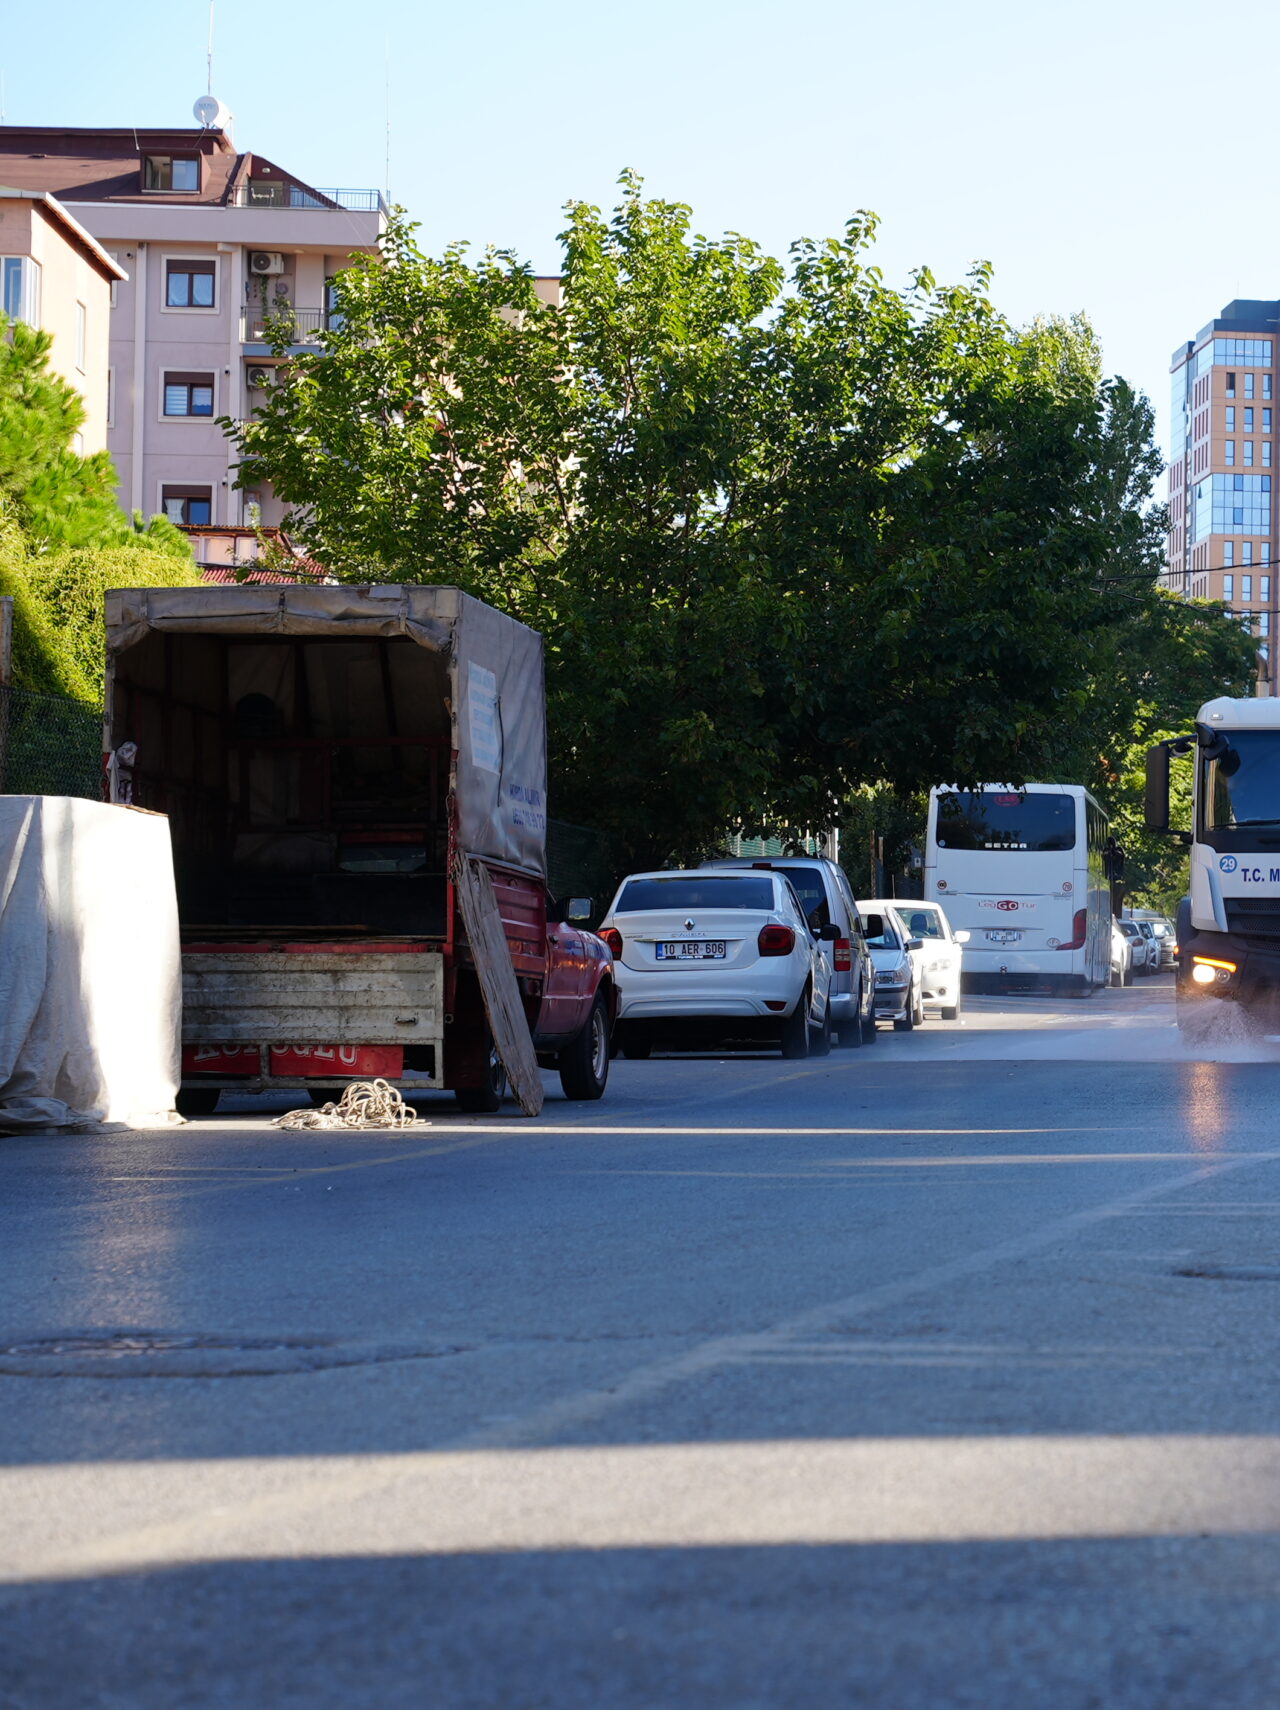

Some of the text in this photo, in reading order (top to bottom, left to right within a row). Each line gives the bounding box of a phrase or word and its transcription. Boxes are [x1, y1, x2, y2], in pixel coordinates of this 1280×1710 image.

[1221, 858, 1235, 871] 29
[1241, 868, 1265, 882] T.C.
[664, 943, 724, 955] 10 AER 606
